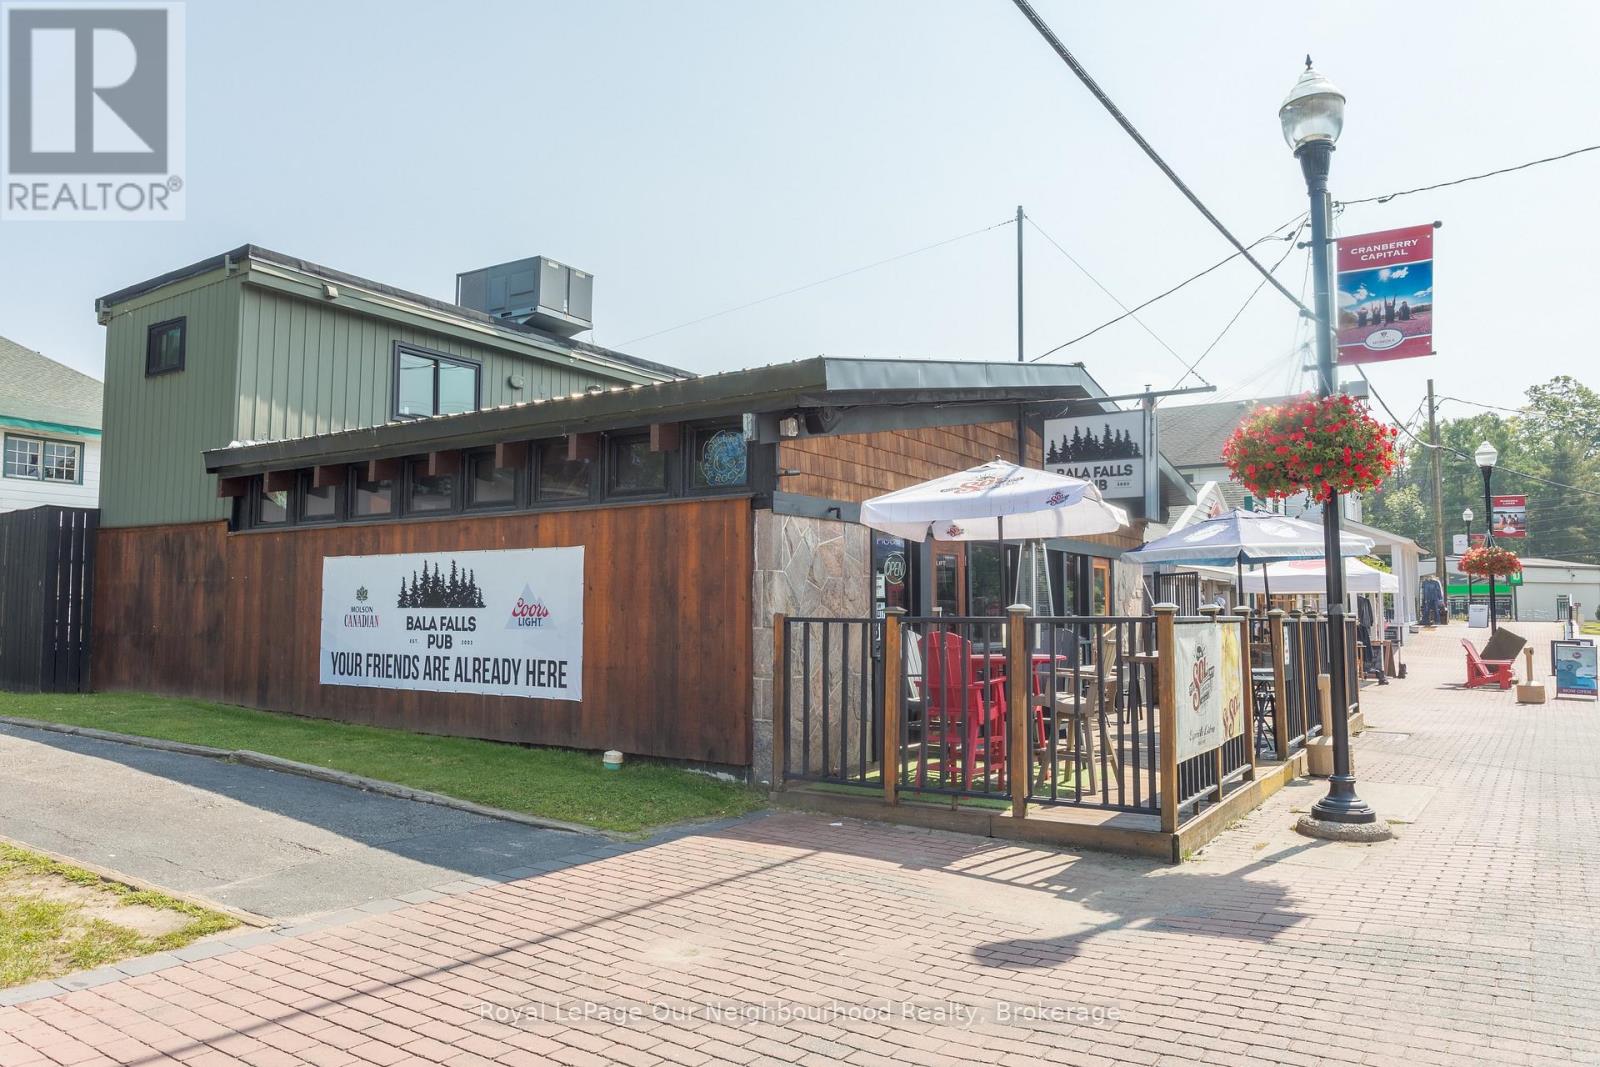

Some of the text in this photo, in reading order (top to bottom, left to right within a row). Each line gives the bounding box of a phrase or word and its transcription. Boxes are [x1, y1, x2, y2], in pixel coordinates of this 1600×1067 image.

[1350, 238, 1418, 255] CRANBERRY
[1360, 249, 1409, 261] CAPITAL
[1094, 464, 1133, 477] FALLS
[886, 561, 905, 576] OPEN
[350, 605, 374, 613] MOLSON
[511, 597, 549, 617] Coors
[344, 614, 380, 628] CANADIAN
[406, 615, 477, 632] BALA FALLS
[518, 617, 542, 627] LIGHT
[427, 634, 453, 650] PUB
[331, 651, 568, 689] YOUR FRIENDS ARE ALREADY HERE
